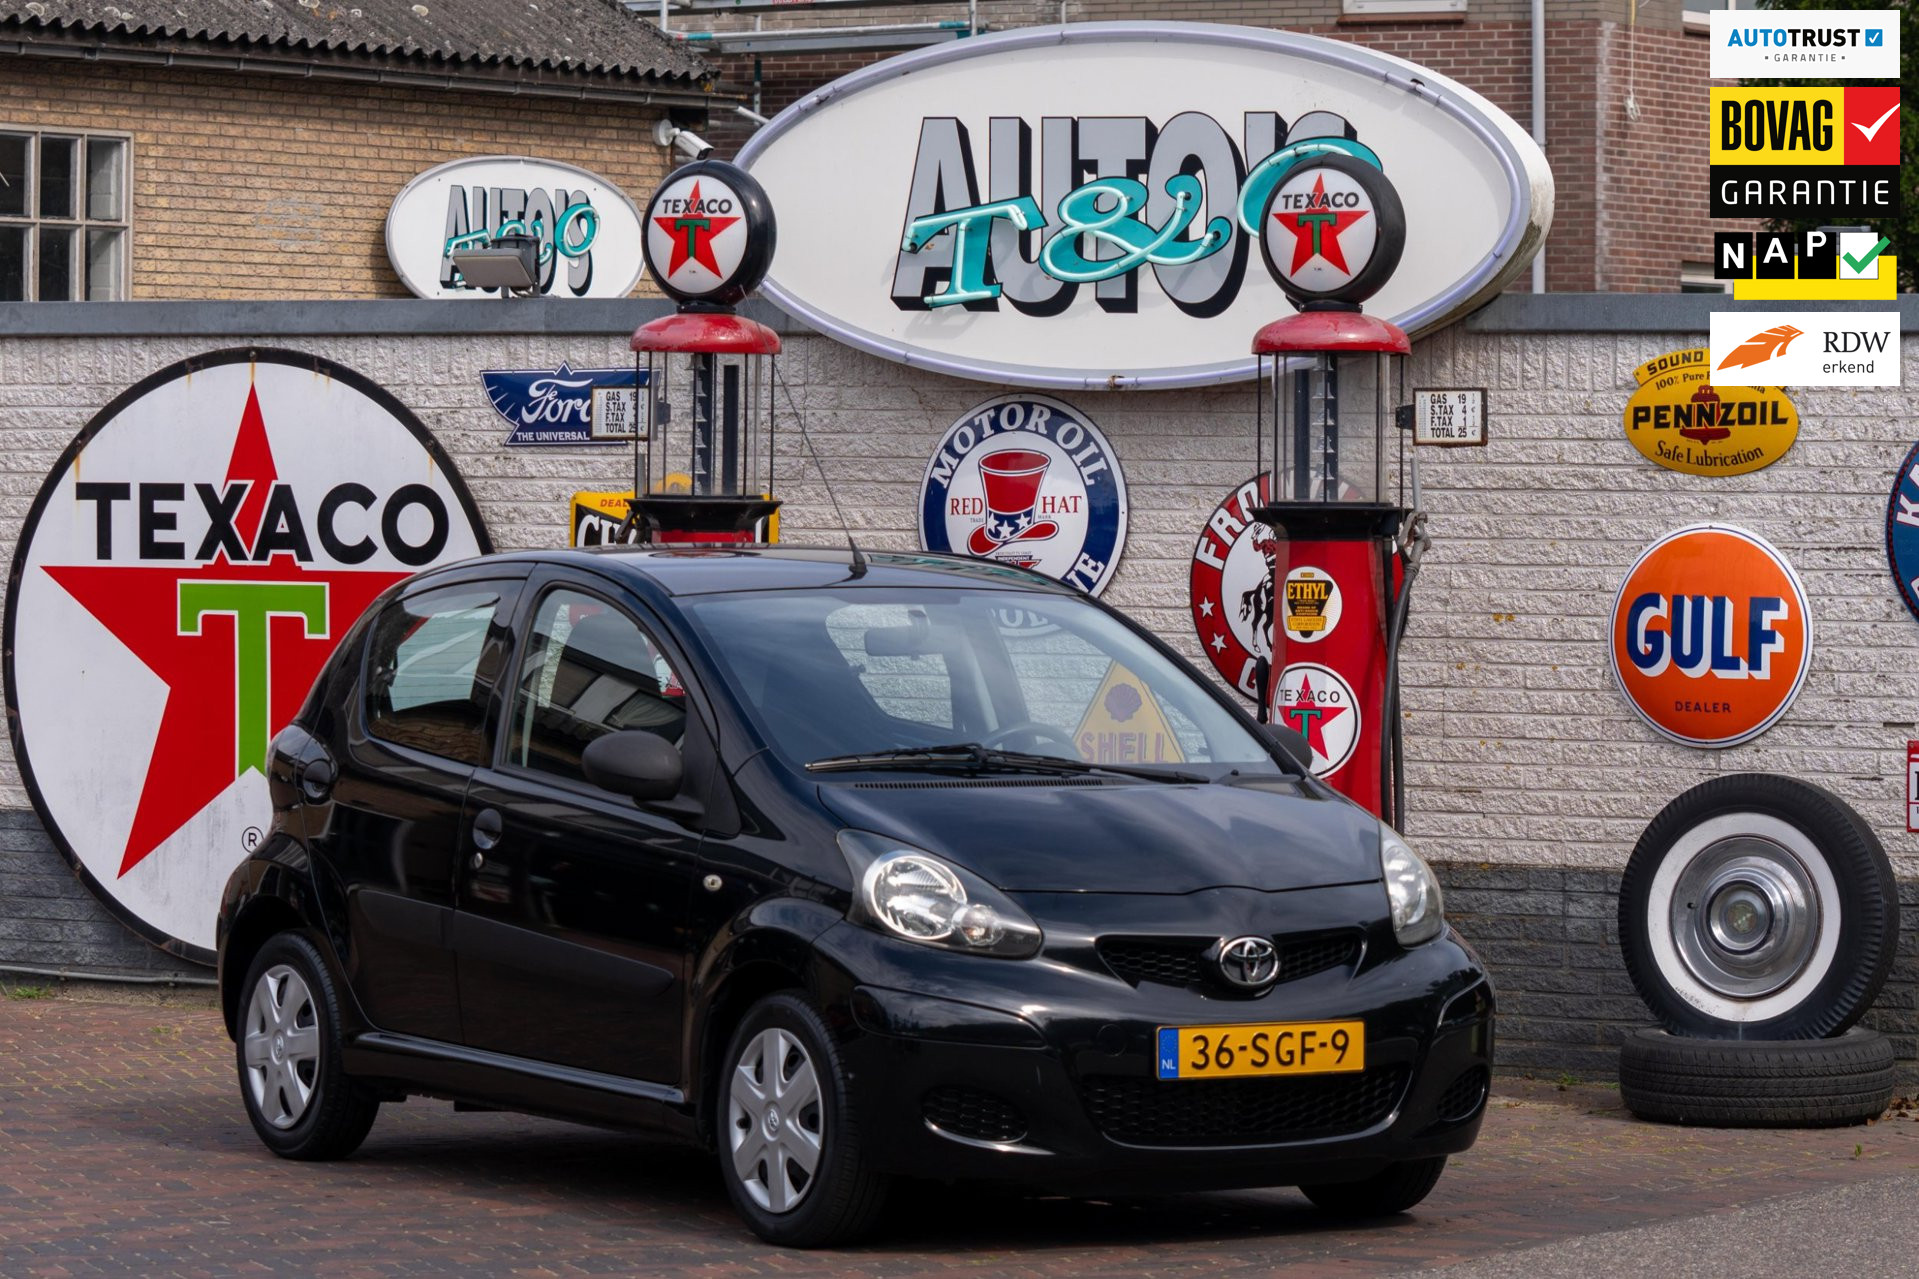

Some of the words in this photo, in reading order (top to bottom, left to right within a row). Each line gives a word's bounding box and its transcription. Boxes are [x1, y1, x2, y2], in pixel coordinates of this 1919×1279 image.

[662, 198, 732, 214] TEXACO
[1282, 191, 1360, 209] TEXACO
[891, 111, 1358, 319] AUTO'
[1647, 350, 1704, 376] SOUND
[1655, 375, 1680, 391] 100%
[1682, 371, 1705, 383] Pure
[606, 391, 621, 402] GAS
[1430, 393, 1448, 405] GAS
[1457, 393, 1467, 405] 19
[605, 402, 627, 412] S.TAX
[1430, 405, 1454, 415] S.TAX
[1632, 401, 1789, 430] PENNZOIL
[605, 412, 625, 423] F.TAX
[1430, 416, 1453, 427] F.TAX
[516, 431, 535, 441] THE
[536, 431, 590, 441] UNIVERSAL
[605, 423, 627, 433] TOTAL
[1430, 427, 1455, 438] TOTAL
[1457, 427, 1468, 438] 25
[931, 403, 1052, 490] MOTOR
[1056, 422, 1108, 486] OIL
[1655, 440, 1684, 464] Safe
[1686, 447, 1765, 467] Lubrication
[950, 498, 984, 516] RED
[1042, 495, 1082, 514] HAT
[75, 482, 450, 567] TEXACO
[1287, 582, 1328, 600] ETHYL
[1626, 592, 1789, 680] GULF
[1280, 689, 1340, 703] TEXACO
[1674, 701, 1731, 713] DEALER
[1080, 731, 1168, 764] SHELL
[1161, 1059, 1176, 1070] NL
[1191, 1028, 1350, 1071] 36-SGF-9
